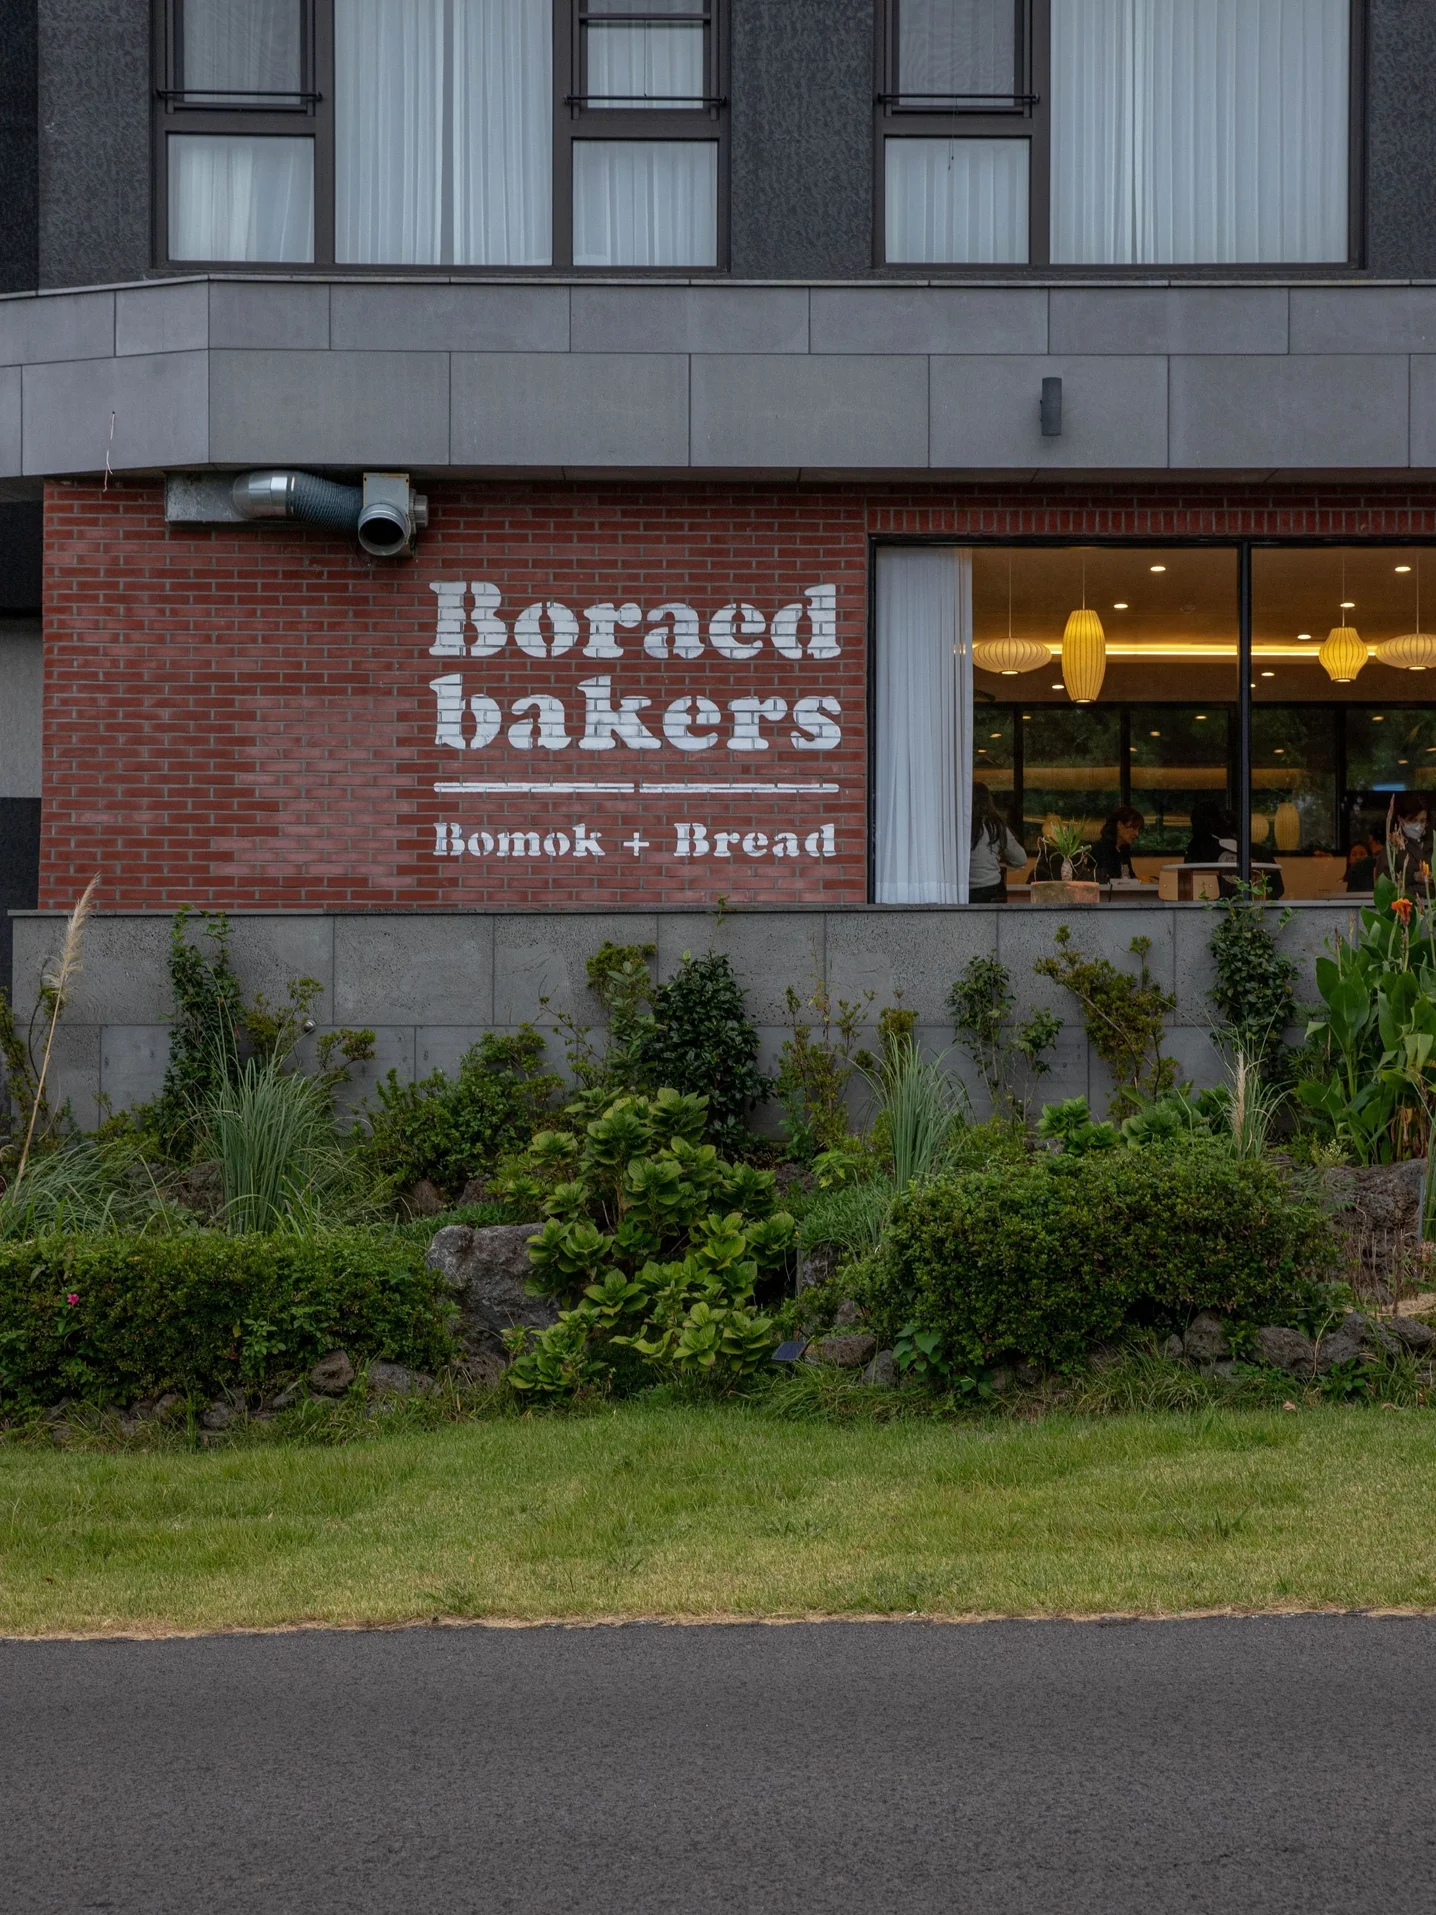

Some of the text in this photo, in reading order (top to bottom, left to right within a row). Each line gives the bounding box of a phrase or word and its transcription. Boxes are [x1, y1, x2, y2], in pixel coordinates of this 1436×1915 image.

[429, 580, 841, 659] Boraed
[429, 673, 841, 751] bakers
[433, 822, 836, 857] Bomok + Bread
